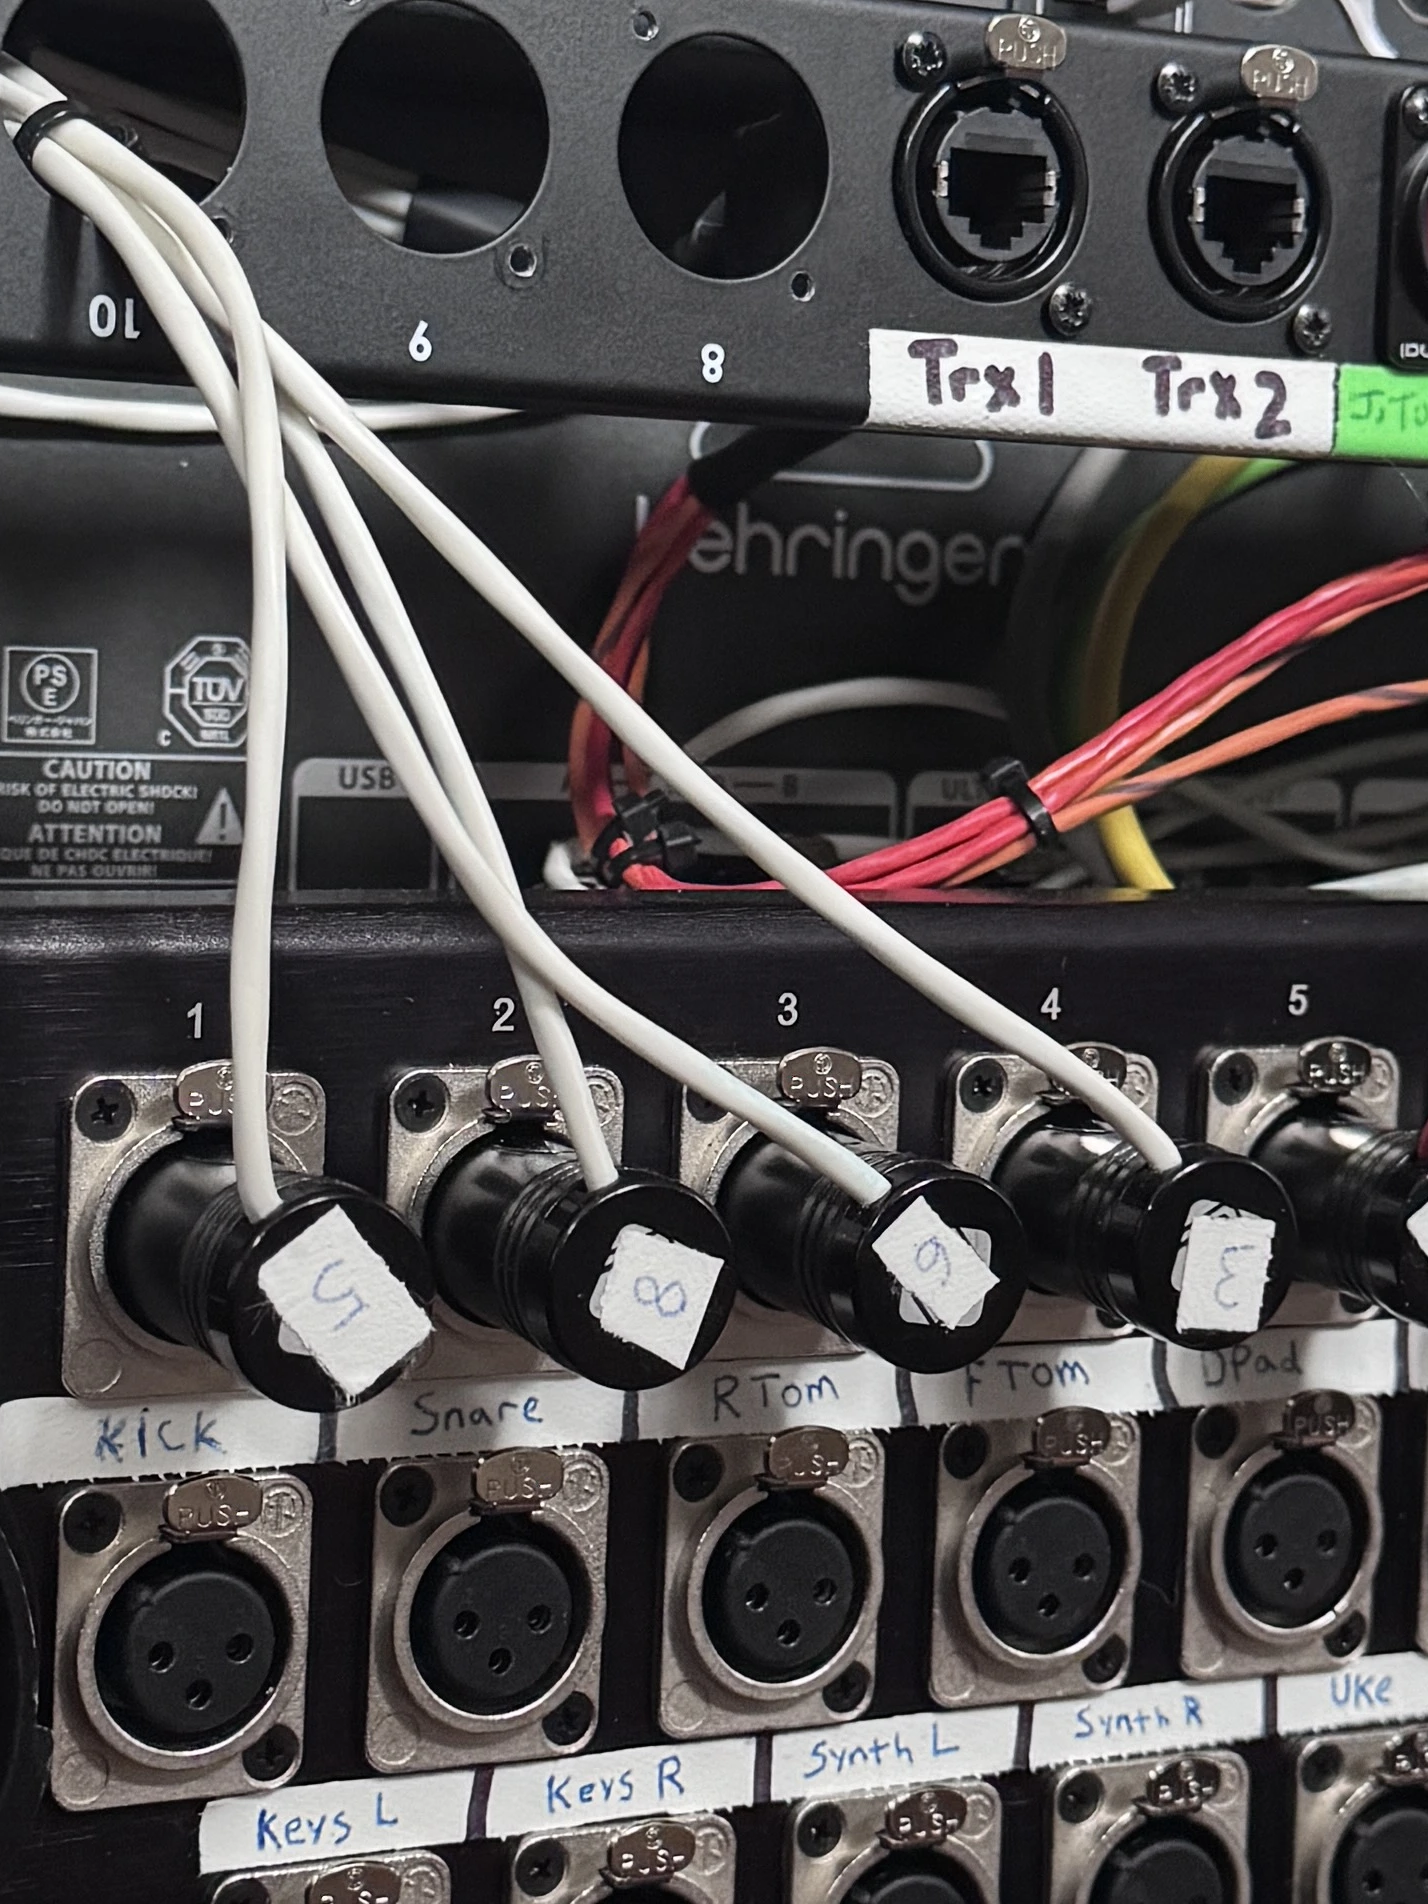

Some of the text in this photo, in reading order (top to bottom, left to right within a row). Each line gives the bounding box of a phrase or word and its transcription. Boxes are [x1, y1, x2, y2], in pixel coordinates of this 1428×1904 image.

[995, 36, 1058, 67] PUSH
[88, 293, 141, 341] 10
[700, 342, 726, 385] 8
[635, 495, 1029, 607] ehringer
[42, 760, 152, 781] CAUTION
[338, 764, 397, 792] USB
[34, 783, 57, 797] OF
[61, 783, 136, 798] ELECTRIC
[138, 785, 199, 800] SHOCK!
[37, 800, 155, 815] DO NOT OPEN!
[27, 824, 162, 845] ATTENTION
[56, 865, 90, 879] PAS
[491, 997, 516, 1032] 2
[777, 992, 799, 1026] 3
[1040, 987, 1062, 1021] 4
[1287, 983, 1310, 1016] 5
[185, 1001, 204, 1039] 1
[633, 1274, 689, 1320] 8
[410, 1395, 545, 1436] Snare
[1182, 1694, 1205, 1728] R
[929, 1723, 961, 1758] L
[544, 1755, 686, 1816] Keys R
[255, 1791, 400, 1852] Keys L
